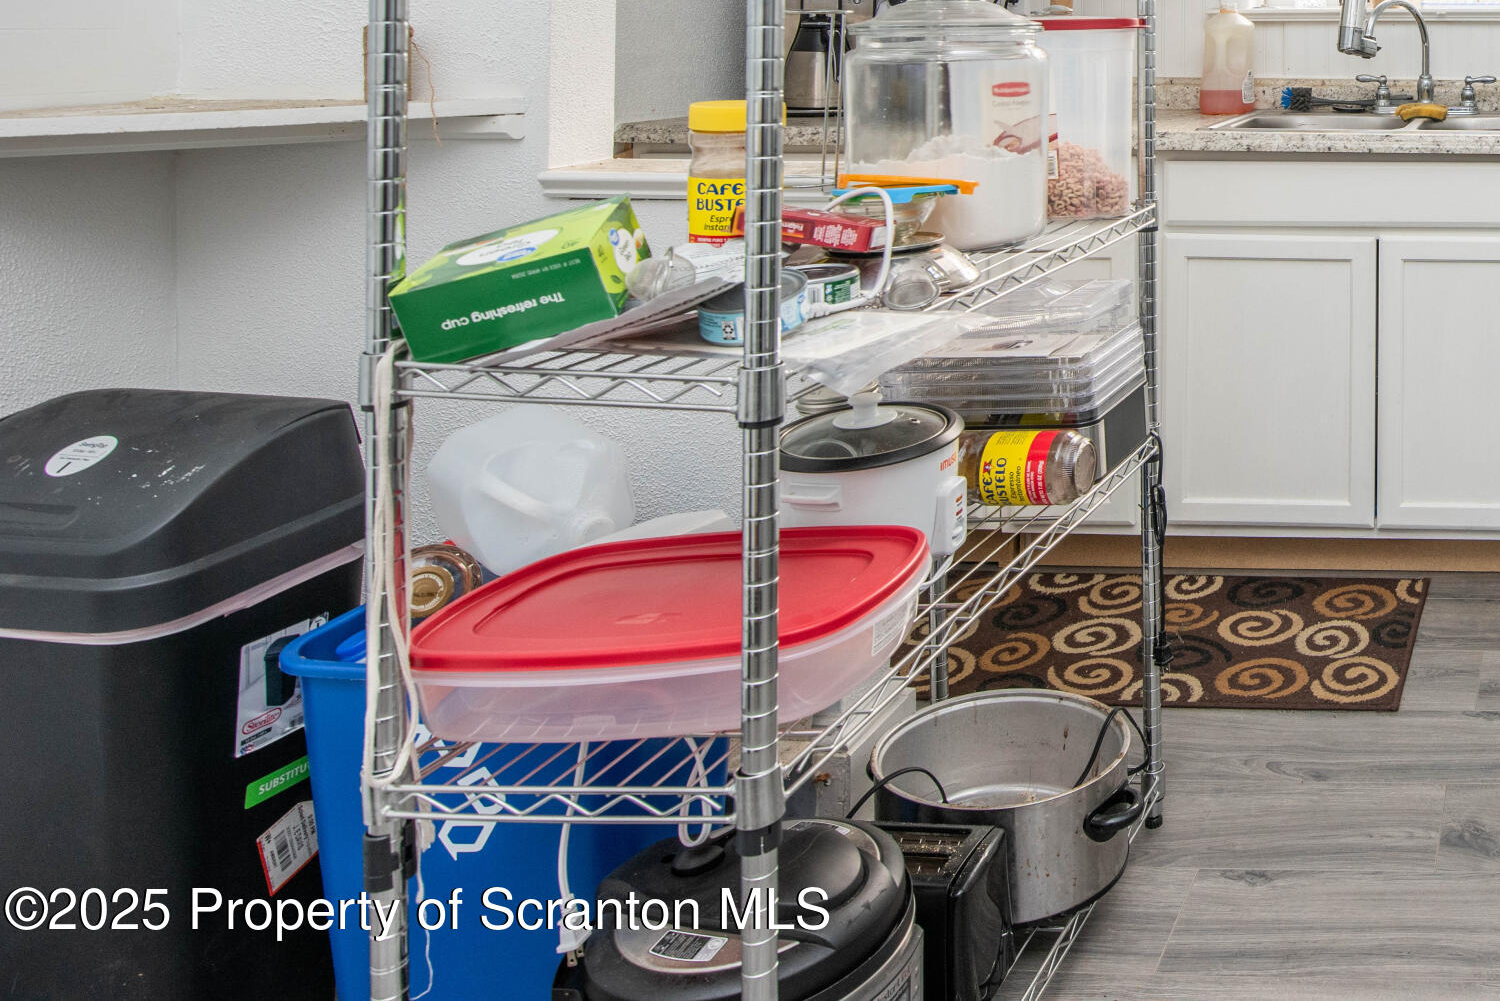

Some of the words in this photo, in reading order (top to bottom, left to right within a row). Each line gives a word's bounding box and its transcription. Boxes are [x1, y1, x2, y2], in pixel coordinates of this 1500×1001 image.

[697, 198, 745, 211] BUSTE
[539, 291, 565, 306] The
[470, 296, 538, 323] refreshing
[440, 316, 470, 331] cup
[258, 762, 308, 796] SUBSTITU
